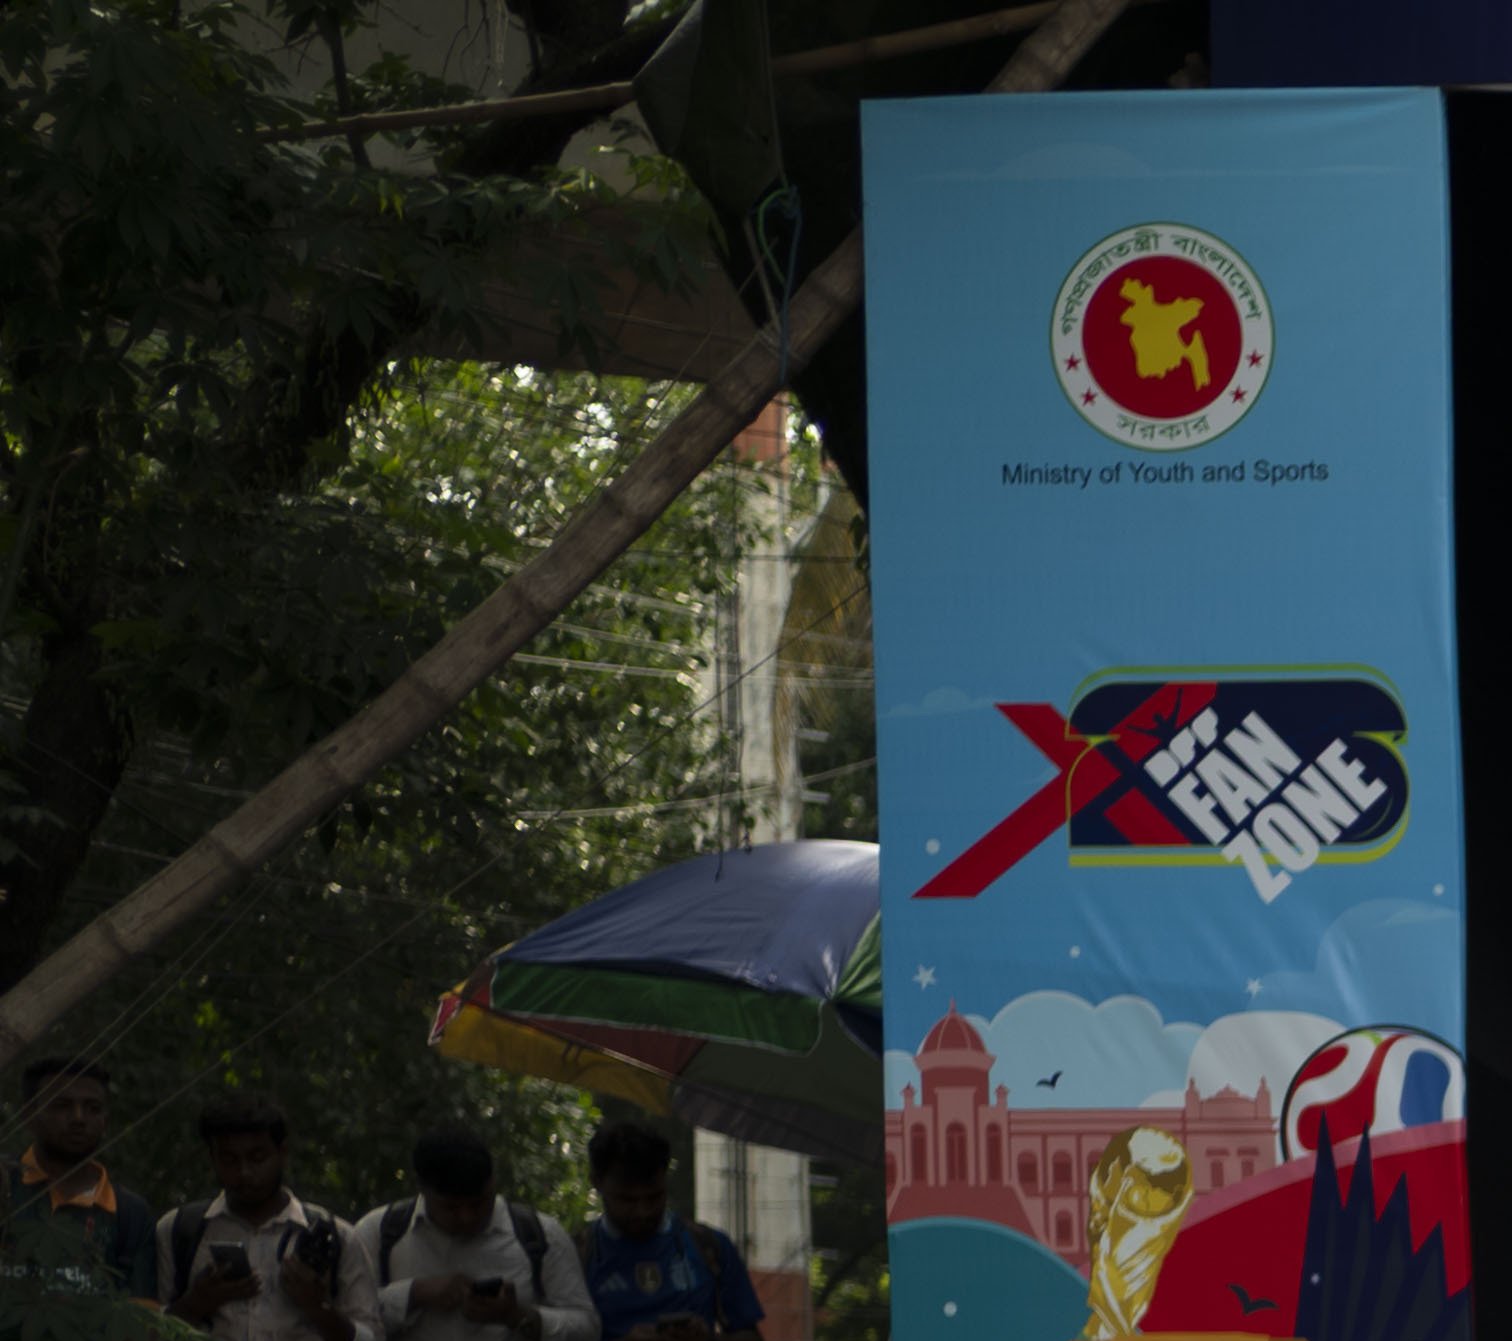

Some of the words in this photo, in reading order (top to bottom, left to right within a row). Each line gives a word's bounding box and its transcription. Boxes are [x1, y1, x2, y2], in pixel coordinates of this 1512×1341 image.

[1002, 462, 1092, 488] Ministry
[1099, 462, 1123, 484] of
[1128, 461, 1194, 484] Youth
[1202, 460, 1245, 482] and
[1253, 459, 1329, 486] Sports
[1167, 710, 1303, 847] FAN
[1220, 737, 1388, 905] ZONE
